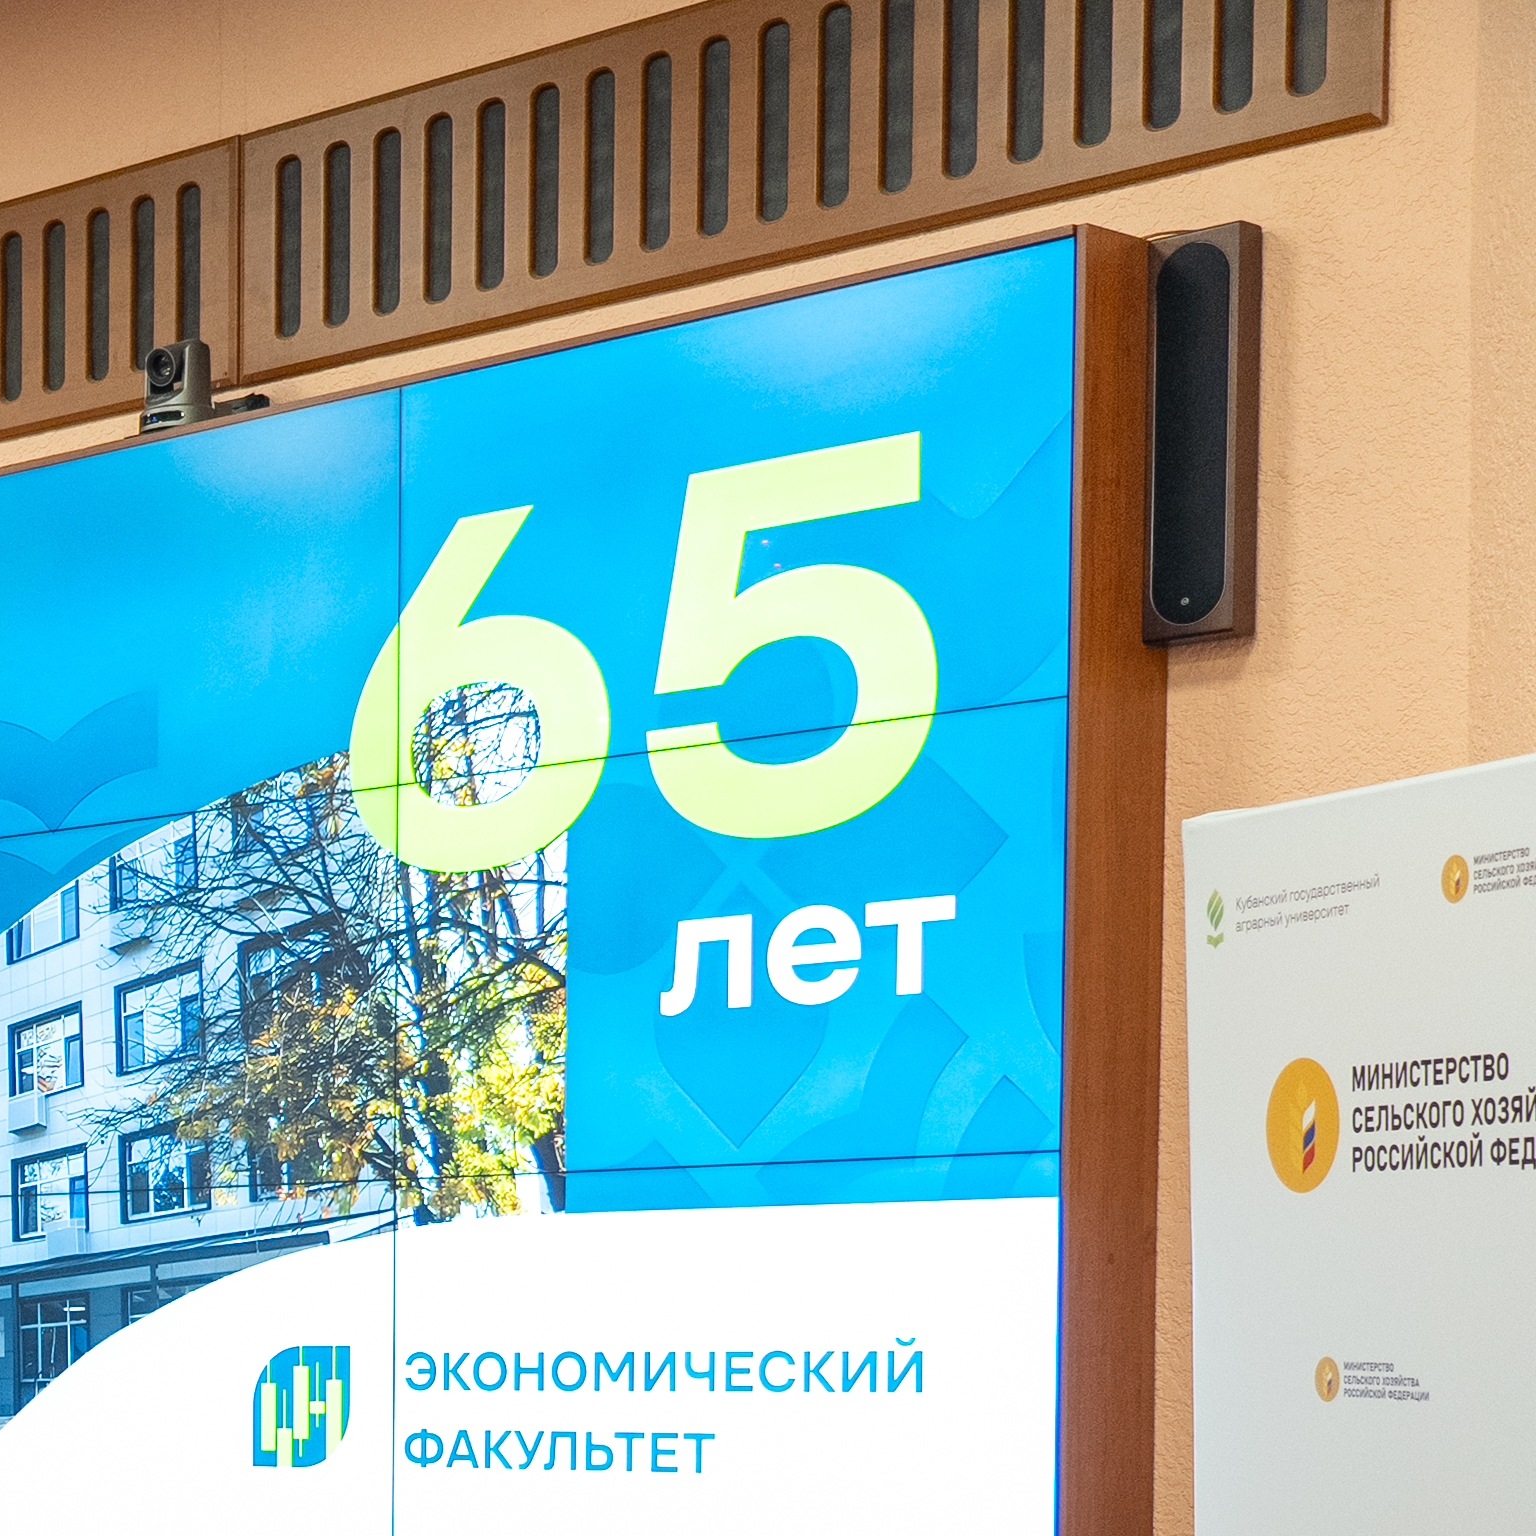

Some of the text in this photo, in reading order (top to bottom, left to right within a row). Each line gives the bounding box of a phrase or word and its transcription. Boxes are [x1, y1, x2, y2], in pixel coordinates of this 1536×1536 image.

[349, 431, 938, 874] 65
[1474, 847, 1530, 865] МИНИСТЕРСТВО
[1474, 858, 1536, 880] СЕЛЬСКОГО ХОЗЯ
[1236, 873, 1380, 914] Кубанский государственный
[1473, 875, 1520, 894] РОССИЙСКОЙ
[1236, 904, 1350, 933] аграрный университет
[659, 894, 956, 1018] лет
[1352, 1052, 1509, 1092] МИНИСТЕРСТВО
[1352, 1086, 1536, 1134] СЕЛЬСКОГО ХОЗЯЙ
[1352, 1132, 1536, 1173] РОССИЙСКОЙ ФЕД
[404, 1337, 925, 1394] ЭКОНОМИЧЕСКИЙ
[1344, 1362, 1394, 1372] МИНИСТЕРСТВО
[1344, 1374, 1420, 1387] СЕЛЬСКОГО ХОЗЯЙСТВА
[1344, 1386, 1430, 1402] РОССИЙСКОЙ ФЕДЕРАЦИИ
[403, 1428, 716, 1474] ФАКУЛЬТЕТ
